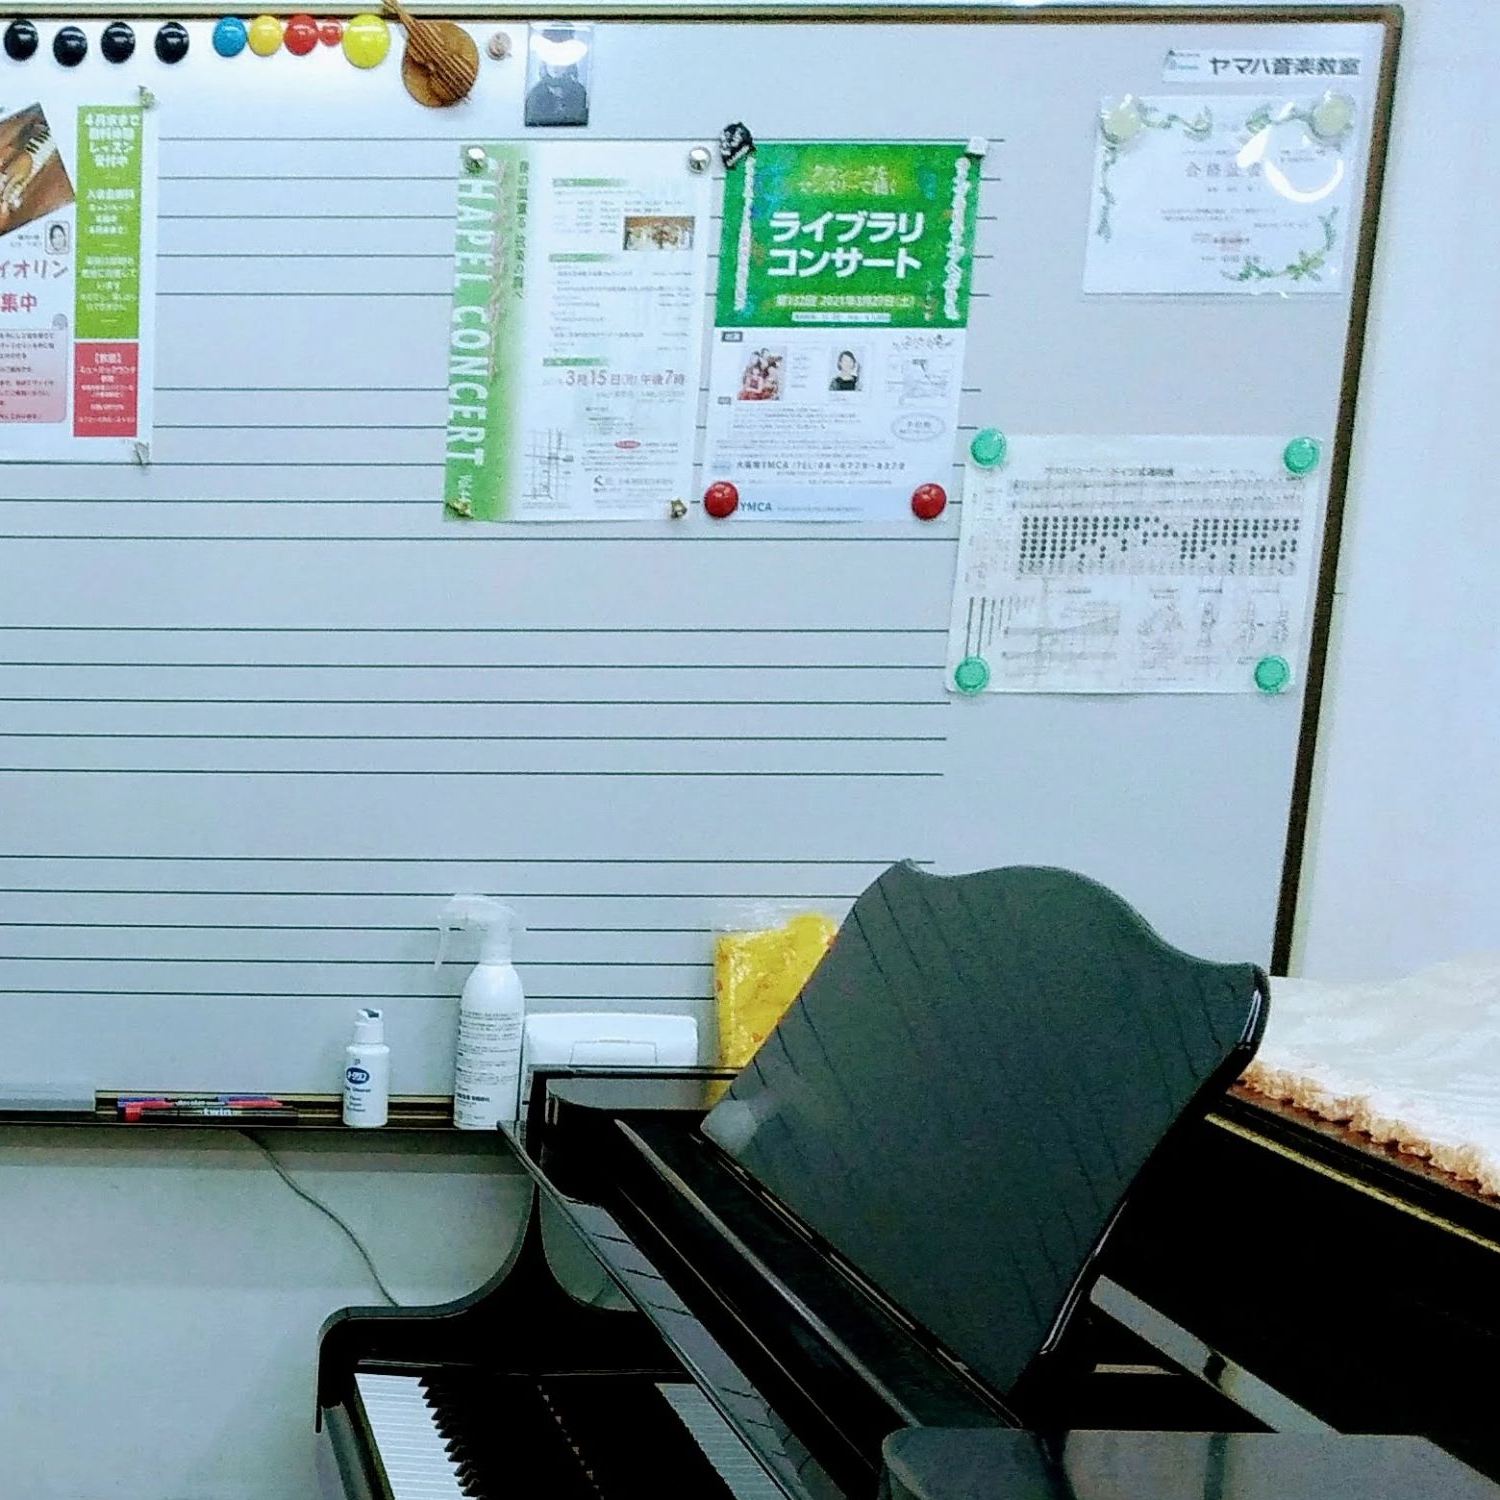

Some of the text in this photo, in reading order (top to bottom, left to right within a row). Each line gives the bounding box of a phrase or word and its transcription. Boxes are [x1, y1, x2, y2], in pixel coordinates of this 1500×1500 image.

[1208, 56, 1361, 76] ヤマハ音楽教室
[769, 210, 925, 244] ライブラリ
[767, 246, 923, 280] コンサート
[446, 305, 493, 467] CONCERT
[739, 502, 773, 512] YMCA
